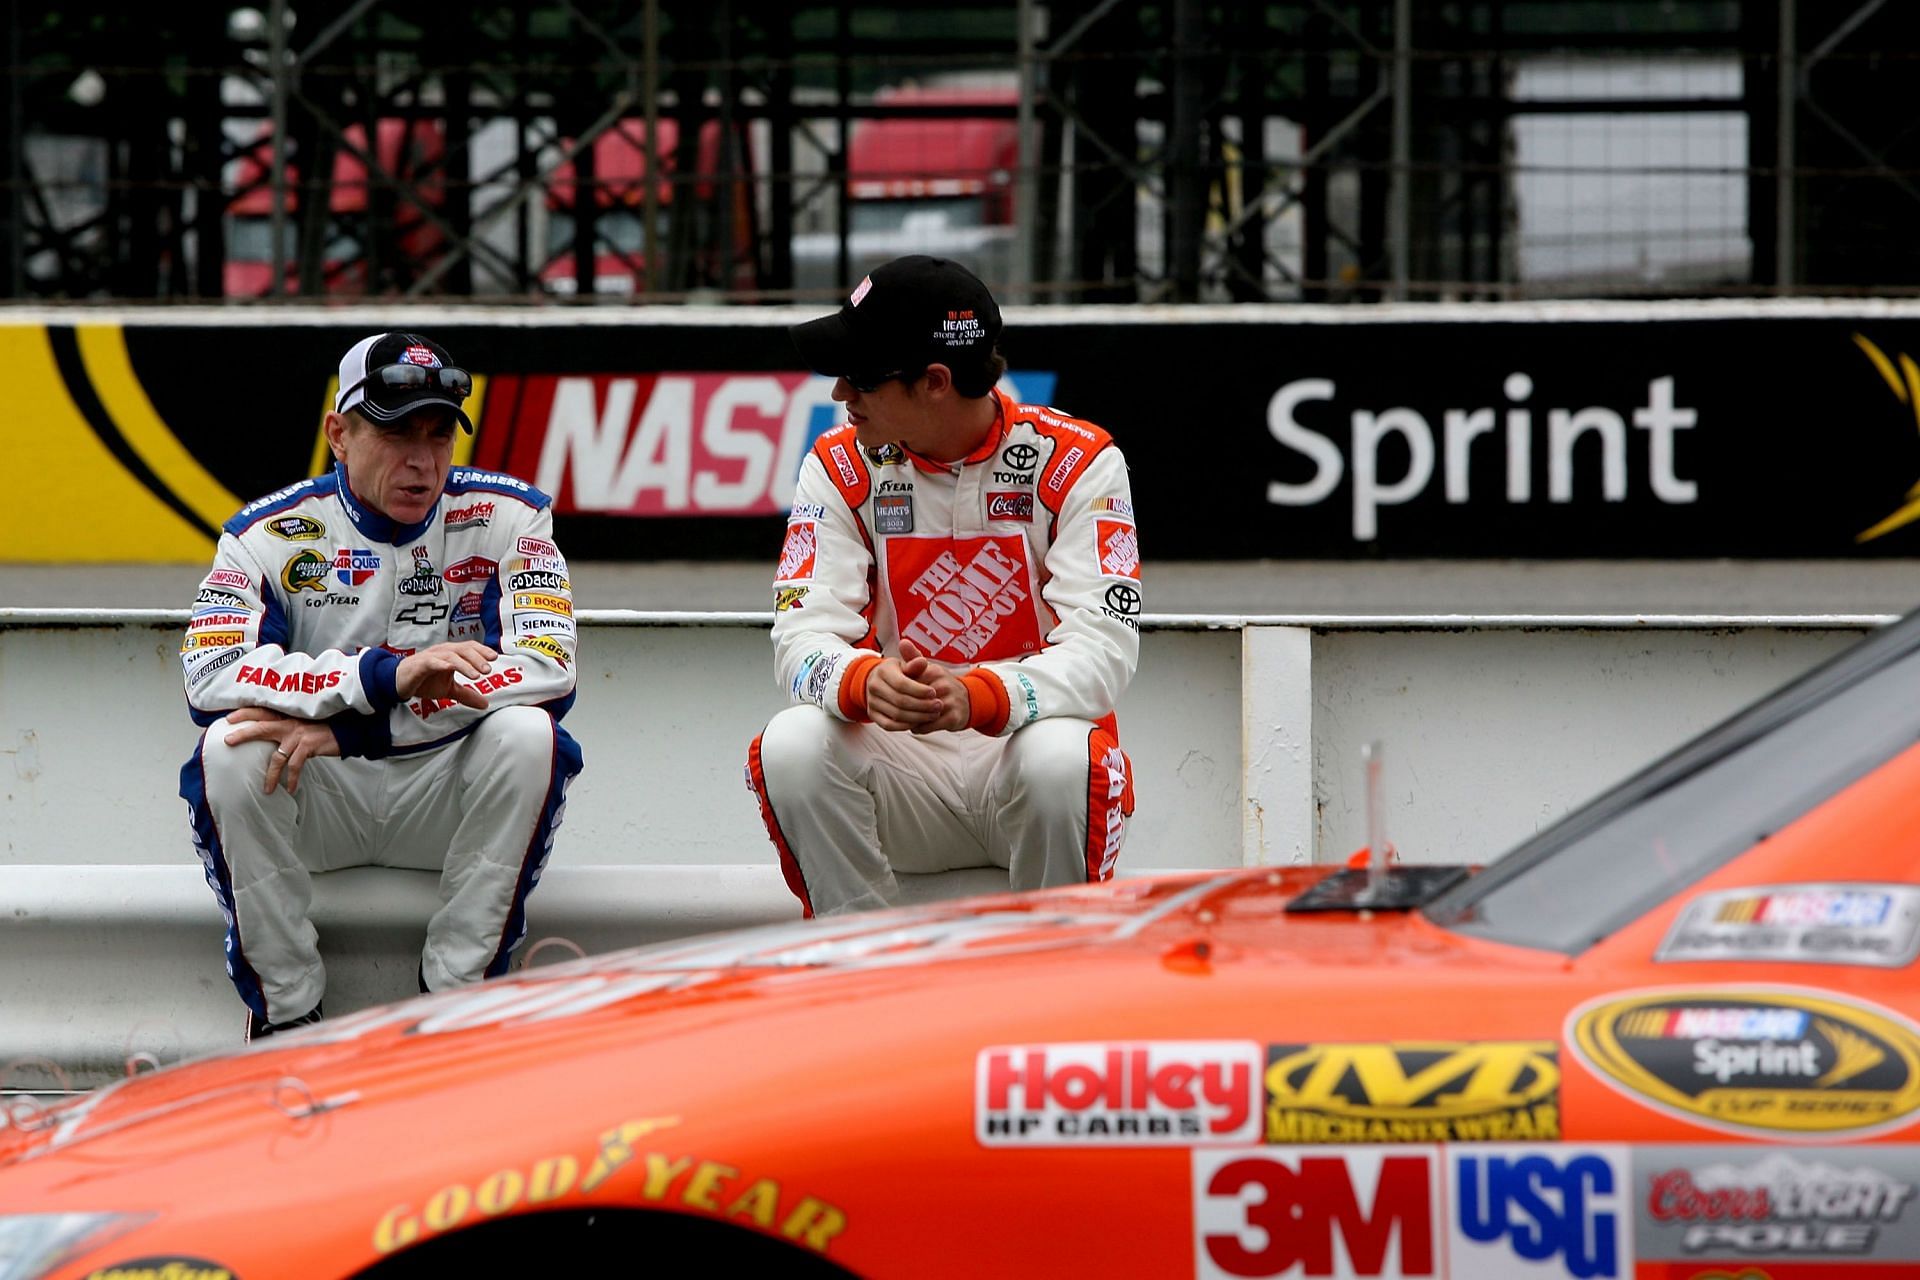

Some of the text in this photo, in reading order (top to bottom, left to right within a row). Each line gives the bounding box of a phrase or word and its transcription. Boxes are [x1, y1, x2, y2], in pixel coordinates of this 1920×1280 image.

[943, 319, 979, 331] HEARTS
[533, 375, 850, 511] NASC
[1266, 372, 1699, 541] Sprint
[452, 471, 530, 492] FARMERS
[832, 446, 859, 486] SIMPSON
[993, 472, 1034, 485] TOYO
[1050, 449, 1081, 490] SIMPSON
[241, 479, 315, 517] FARMERS
[332, 557, 380, 569] CARQUEST
[521, 541, 556, 557] SIMPSON
[208, 571, 246, 585] SIMPSON
[908, 550, 963, 601] THE
[534, 597, 571, 613] BOSCH
[902, 539, 1023, 657] HOME
[190, 613, 249, 630] urolator
[522, 620, 571, 631] SIEMENS
[949, 579, 1028, 660] DEPOT
[200, 636, 242, 646] BOSCH
[519, 640, 571, 662] SUNOCO
[236, 665, 343, 695] FARMERS
[1015, 672, 1039, 722] SIEMEN
[1672, 1007, 1812, 1041] NASCAR
[1693, 1039, 1822, 1083] Sprint
[985, 1047, 1252, 1134] Holley
[986, 1112, 1201, 1136] HP CARBS
[1647, 1168, 1912, 1222] Coors LIGHT
[1203, 1156, 1434, 1278] 3M
[1457, 1154, 1618, 1279] USG
[1684, 1224, 1875, 1254] POLE
